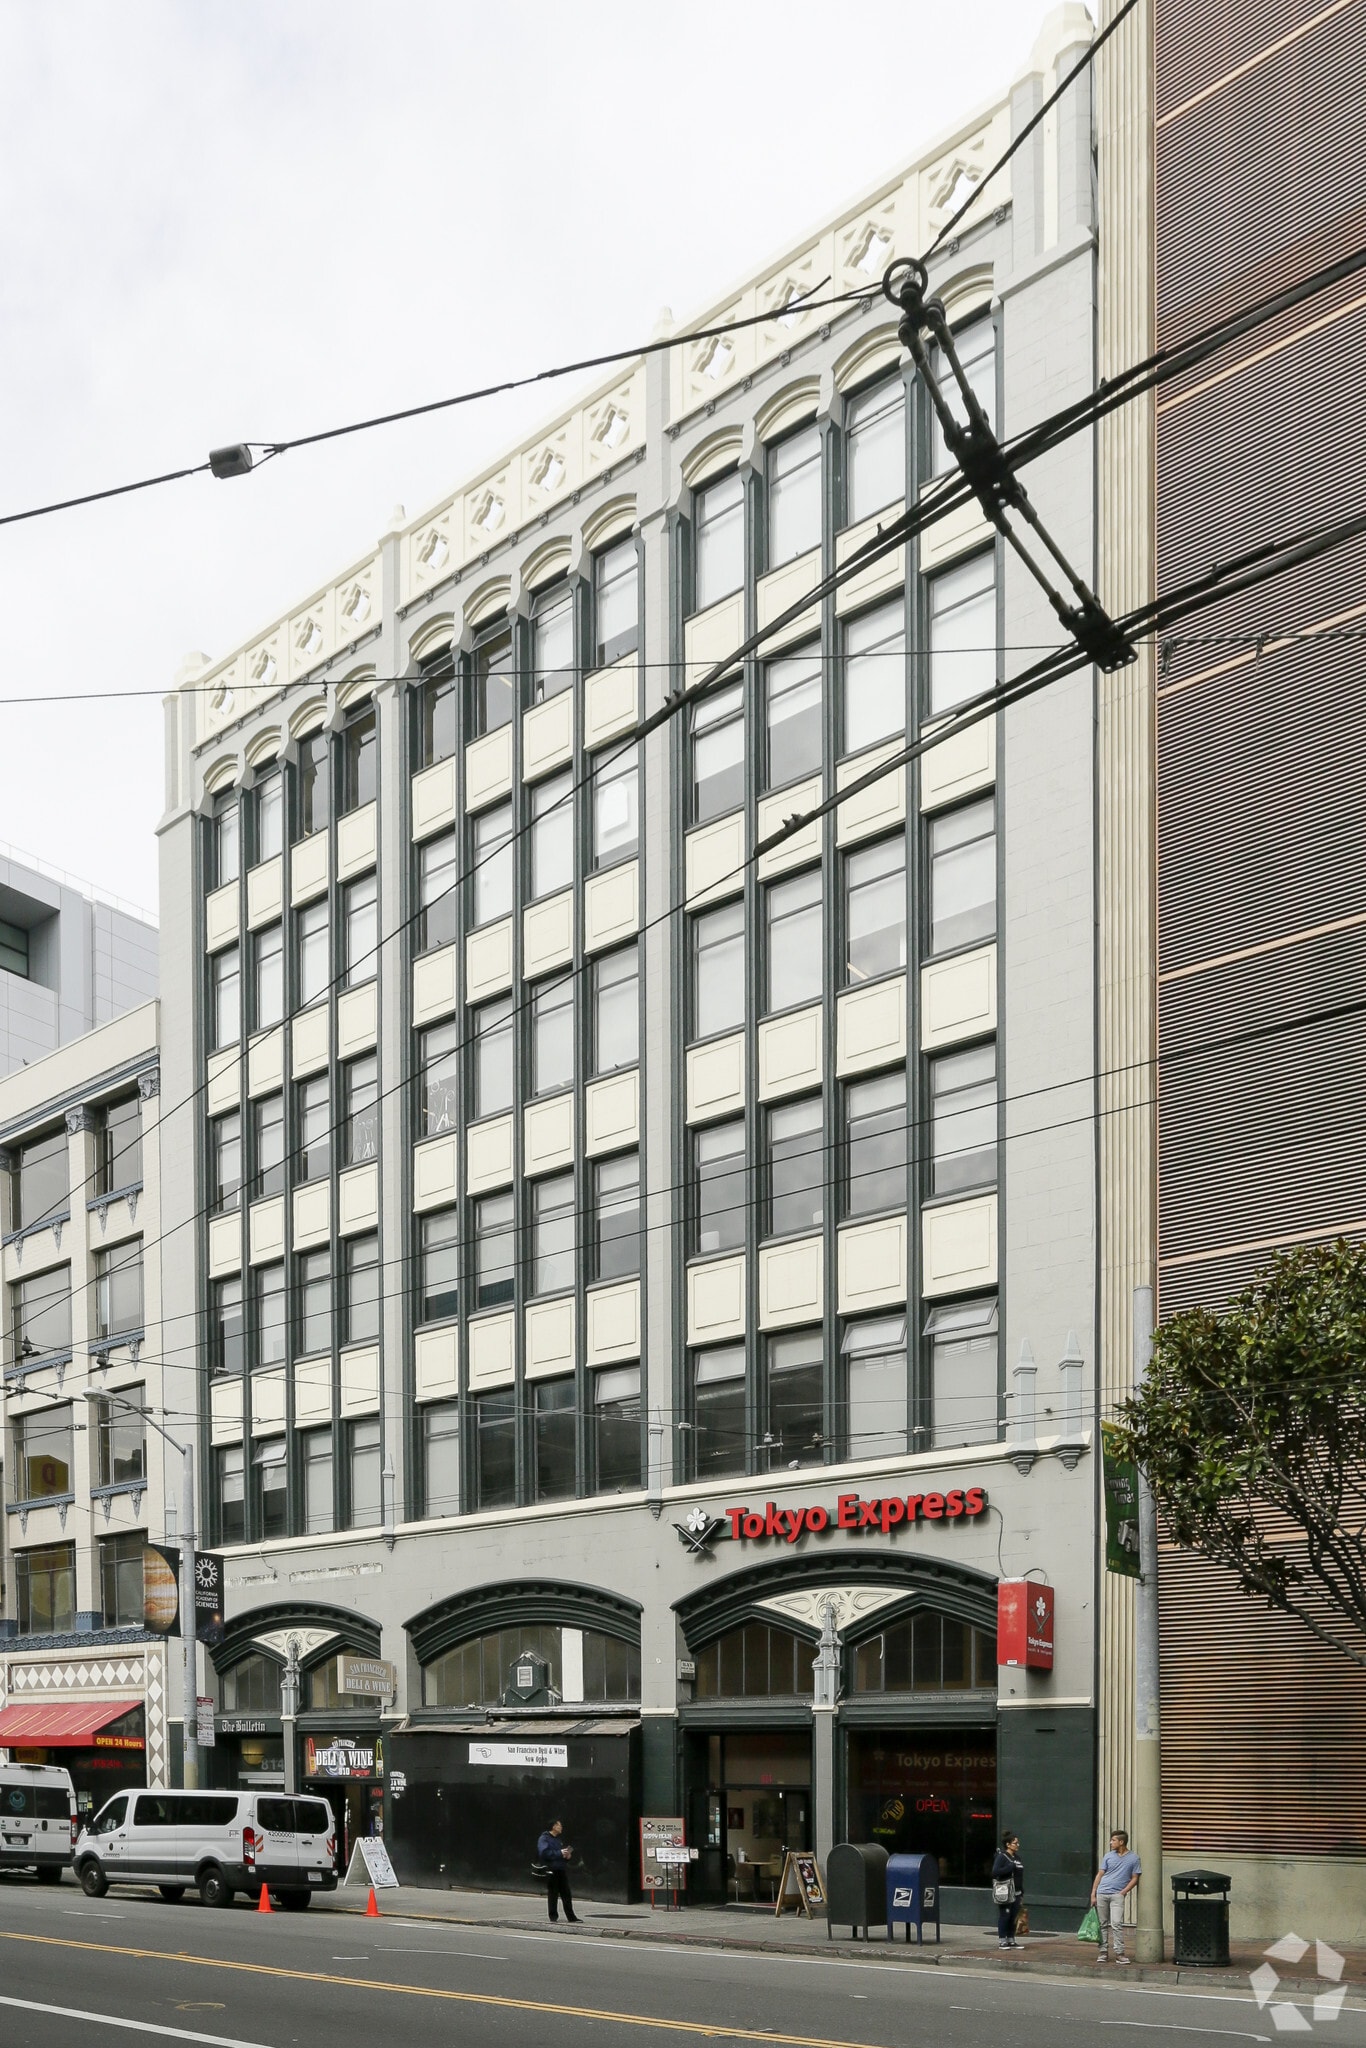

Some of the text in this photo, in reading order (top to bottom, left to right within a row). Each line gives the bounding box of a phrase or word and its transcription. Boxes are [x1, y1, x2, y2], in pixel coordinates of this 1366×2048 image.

[726, 1487, 986, 1543] Tokyo Express
[195, 1601, 219, 1609] SCIENCES
[346, 1678, 391, 1693] DELI & WINE
[221, 1720, 236, 1732] The
[235, 1720, 266, 1732] Bulletin
[96, 1737, 142, 1748] OPEN 24 Hours
[507, 1746, 516, 1754] San
[516, 1746, 538, 1754] Francisco
[554, 1747, 566, 1755] Wine
[315, 1750, 374, 1766] DELI & WINE
[896, 1753, 997, 1770] Tokyo Expres
[915, 1799, 950, 1813] OPEN
